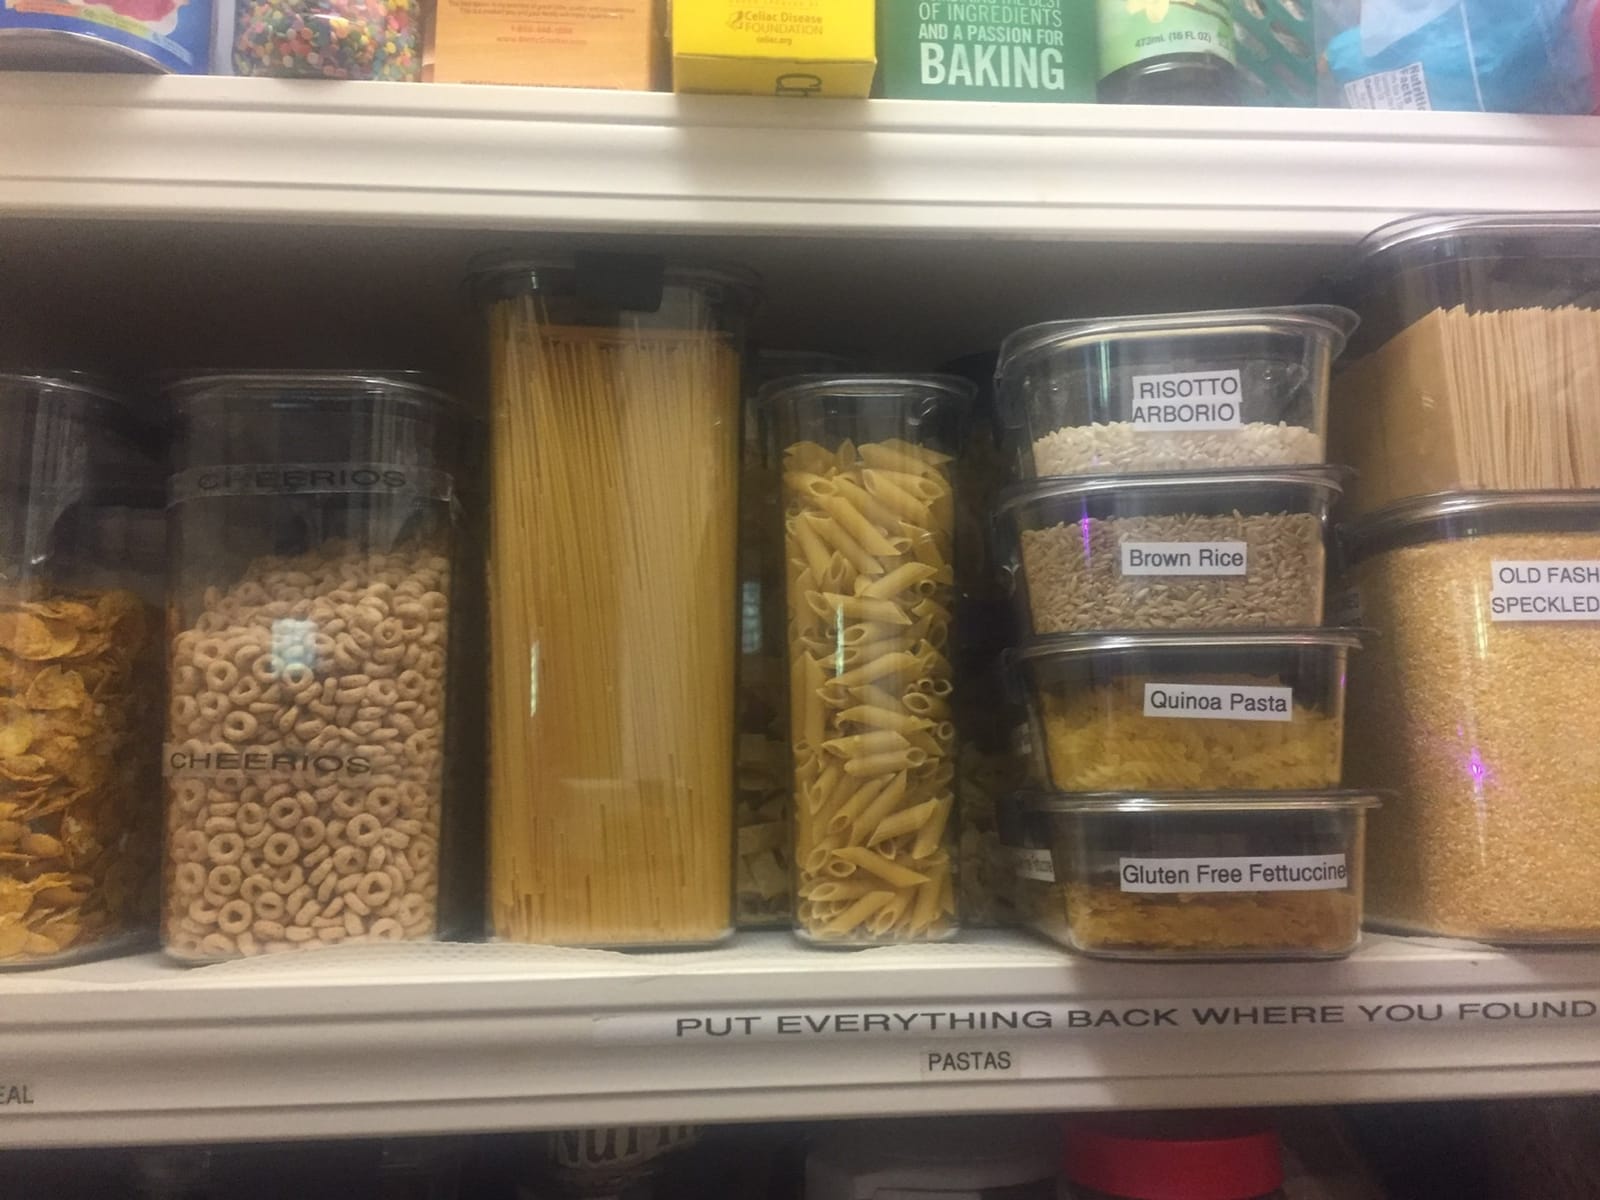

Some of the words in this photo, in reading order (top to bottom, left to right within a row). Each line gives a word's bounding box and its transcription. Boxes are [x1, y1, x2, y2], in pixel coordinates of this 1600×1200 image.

[744, 10, 776, 22] Celiac
[780, 11, 822, 24] Disease
[919, 2, 941, 21] OF
[947, 4, 1062, 27] INGREDIENTS
[744, 23, 823, 35] FOUNDATION
[918, 23, 949, 40] AND
[953, 24, 963, 41] A
[967, 24, 1032, 44] PASSION
[1036, 28, 1063, 46] FOR
[920, 41, 1064, 91] BAKING
[1139, 377, 1238, 399] RISOTTO
[1132, 403, 1235, 423] ARBORIO
[197, 470, 404, 490] CHEERIOS
[1130, 548, 1191, 567] Brown
[1199, 548, 1244, 567] Rice
[1499, 567, 1541, 584] OLD
[1547, 567, 1600, 584] FASH
[1492, 596, 1600, 613] SPECKLED
[1150, 690, 1222, 710] Quinoa
[1230, 693, 1287, 712] Pasta
[170, 752, 370, 774] CHEERIOS
[1122, 864, 1190, 884] Gluten
[1197, 864, 1243, 884] Free
[1249, 861, 1348, 883] Fettuccine
[676, 1016, 761, 1037] PUT
[776, 1010, 1053, 1034] EVERYTHING
[1067, 1007, 1179, 1028] BACK
[1192, 1004, 1345, 1025] WHERE
[1358, 1002, 1443, 1022] YOU
[1458, 1000, 1597, 1020] FOUND
[928, 1052, 1012, 1072] PASTAS
